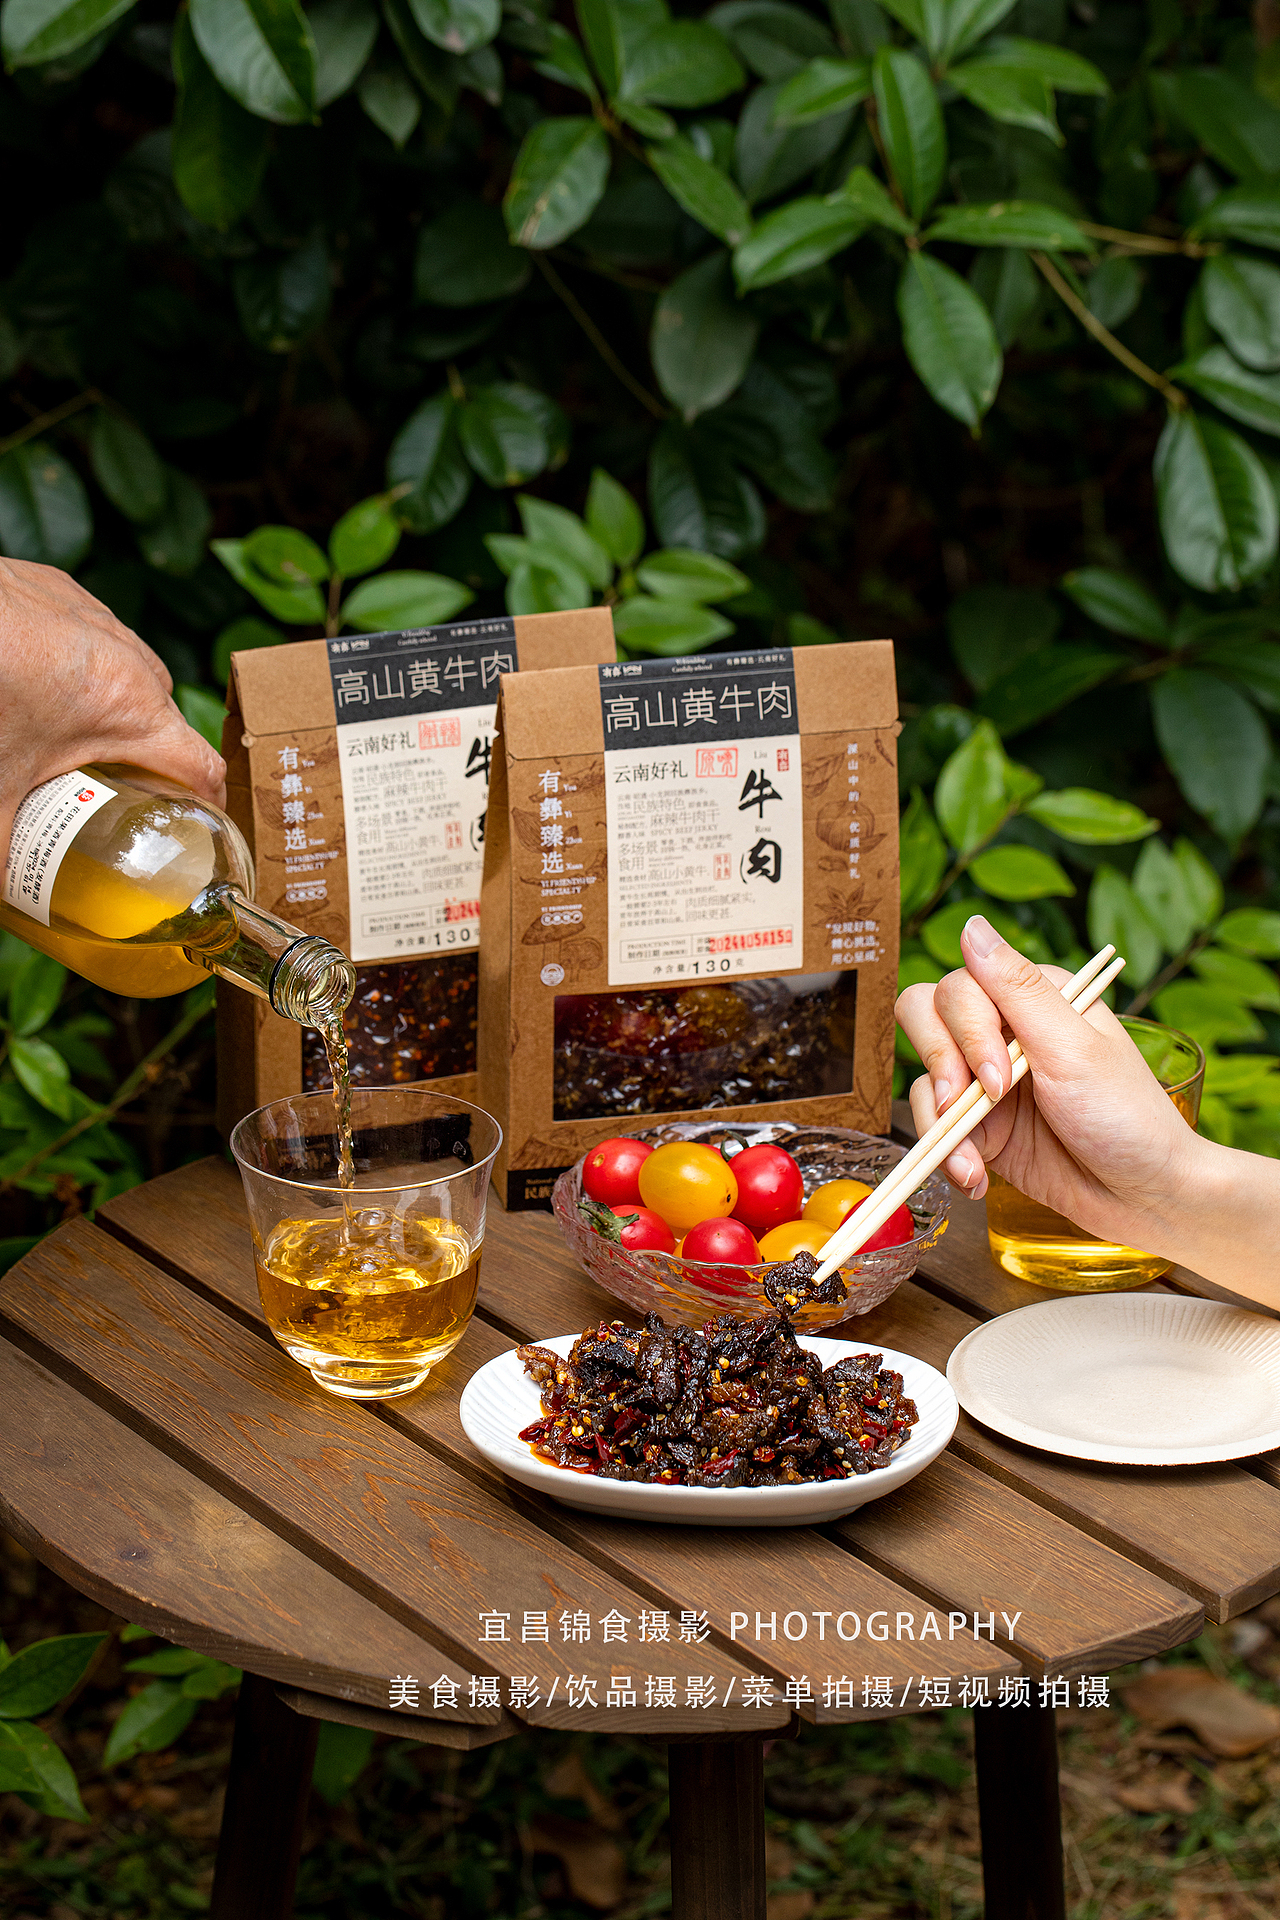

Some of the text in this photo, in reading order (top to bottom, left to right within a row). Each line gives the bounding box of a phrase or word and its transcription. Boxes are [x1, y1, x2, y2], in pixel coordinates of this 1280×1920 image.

[334, 650, 514, 708] 高山黄牛肉
[603, 680, 793, 734] 高山黄牛肉
[346, 731, 416, 757] 云南好礼
[612, 760, 689, 784] 云南好礼
[278, 746, 307, 851] 有彝臻选
[538, 769, 564, 875] 有彝臻选
